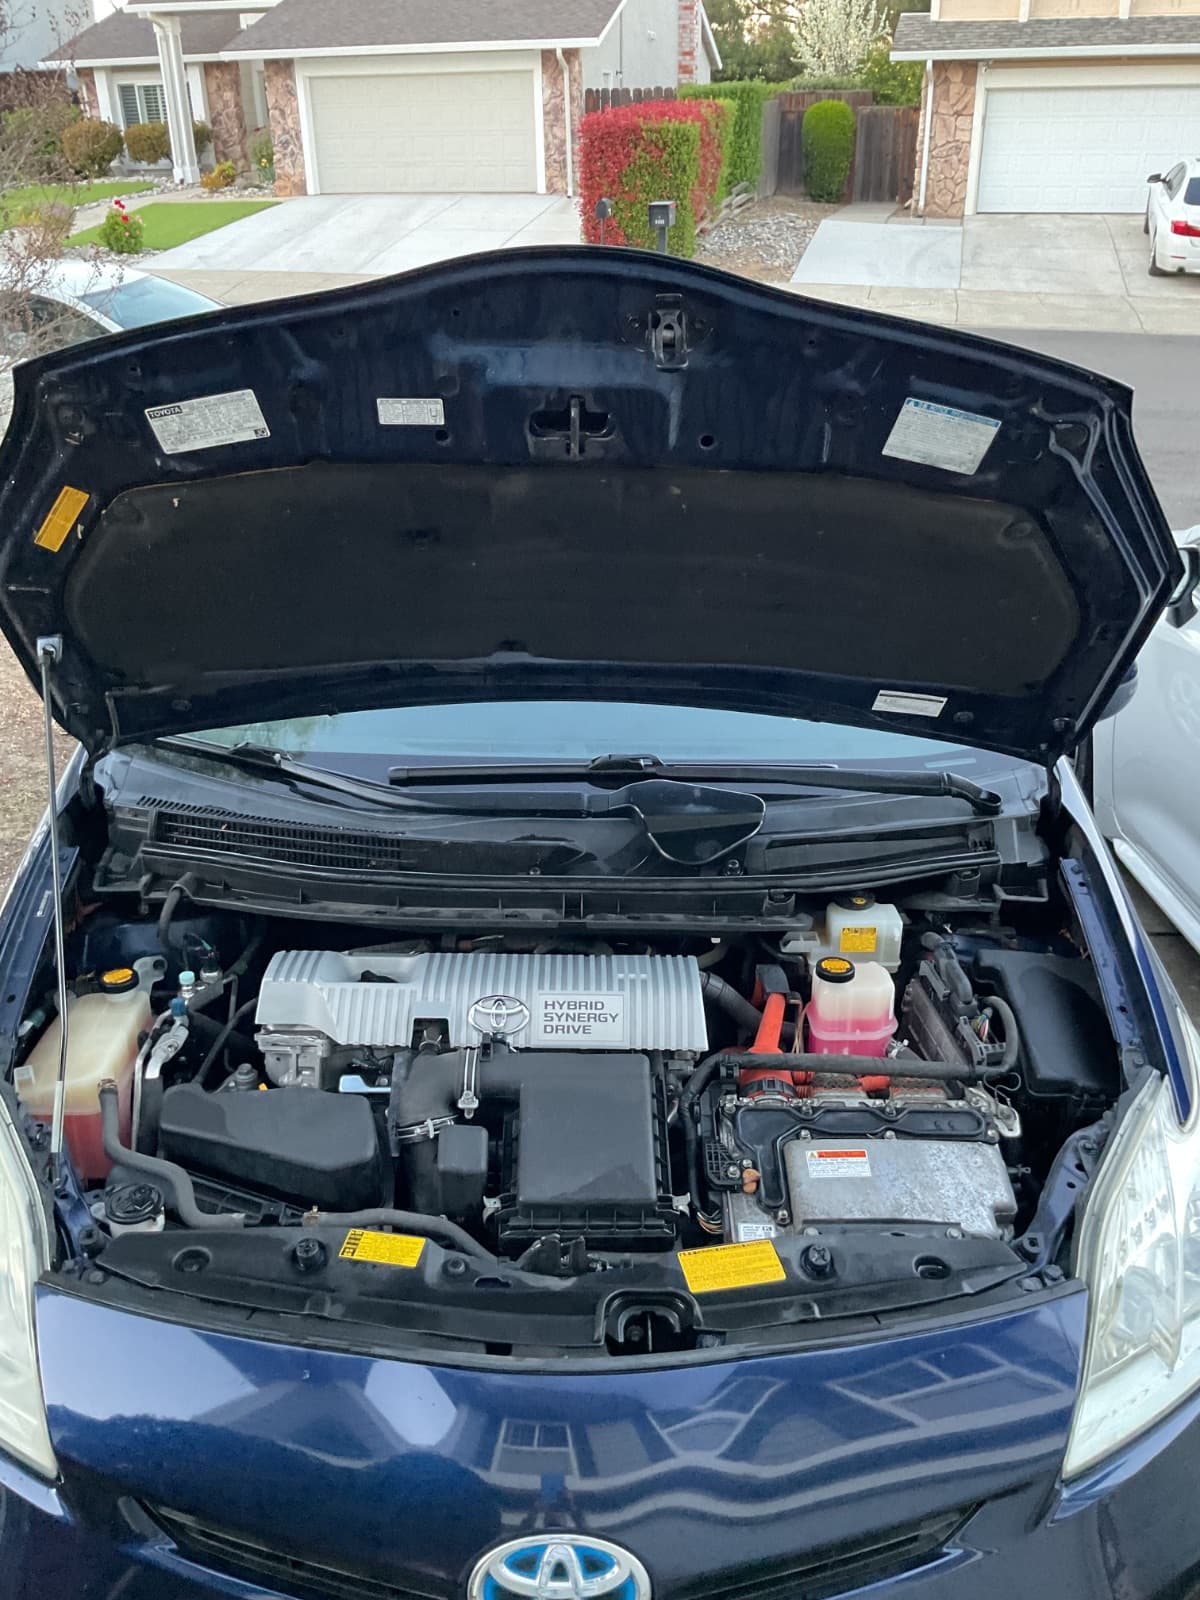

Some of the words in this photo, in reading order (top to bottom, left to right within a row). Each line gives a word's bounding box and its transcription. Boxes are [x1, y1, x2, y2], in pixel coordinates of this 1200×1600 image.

[150, 407, 181, 417] TOYOTA
[544, 1000, 605, 1011] HYBRID
[543, 1012, 619, 1023] SYNERGY
[543, 1024, 592, 1035] DRIVE
